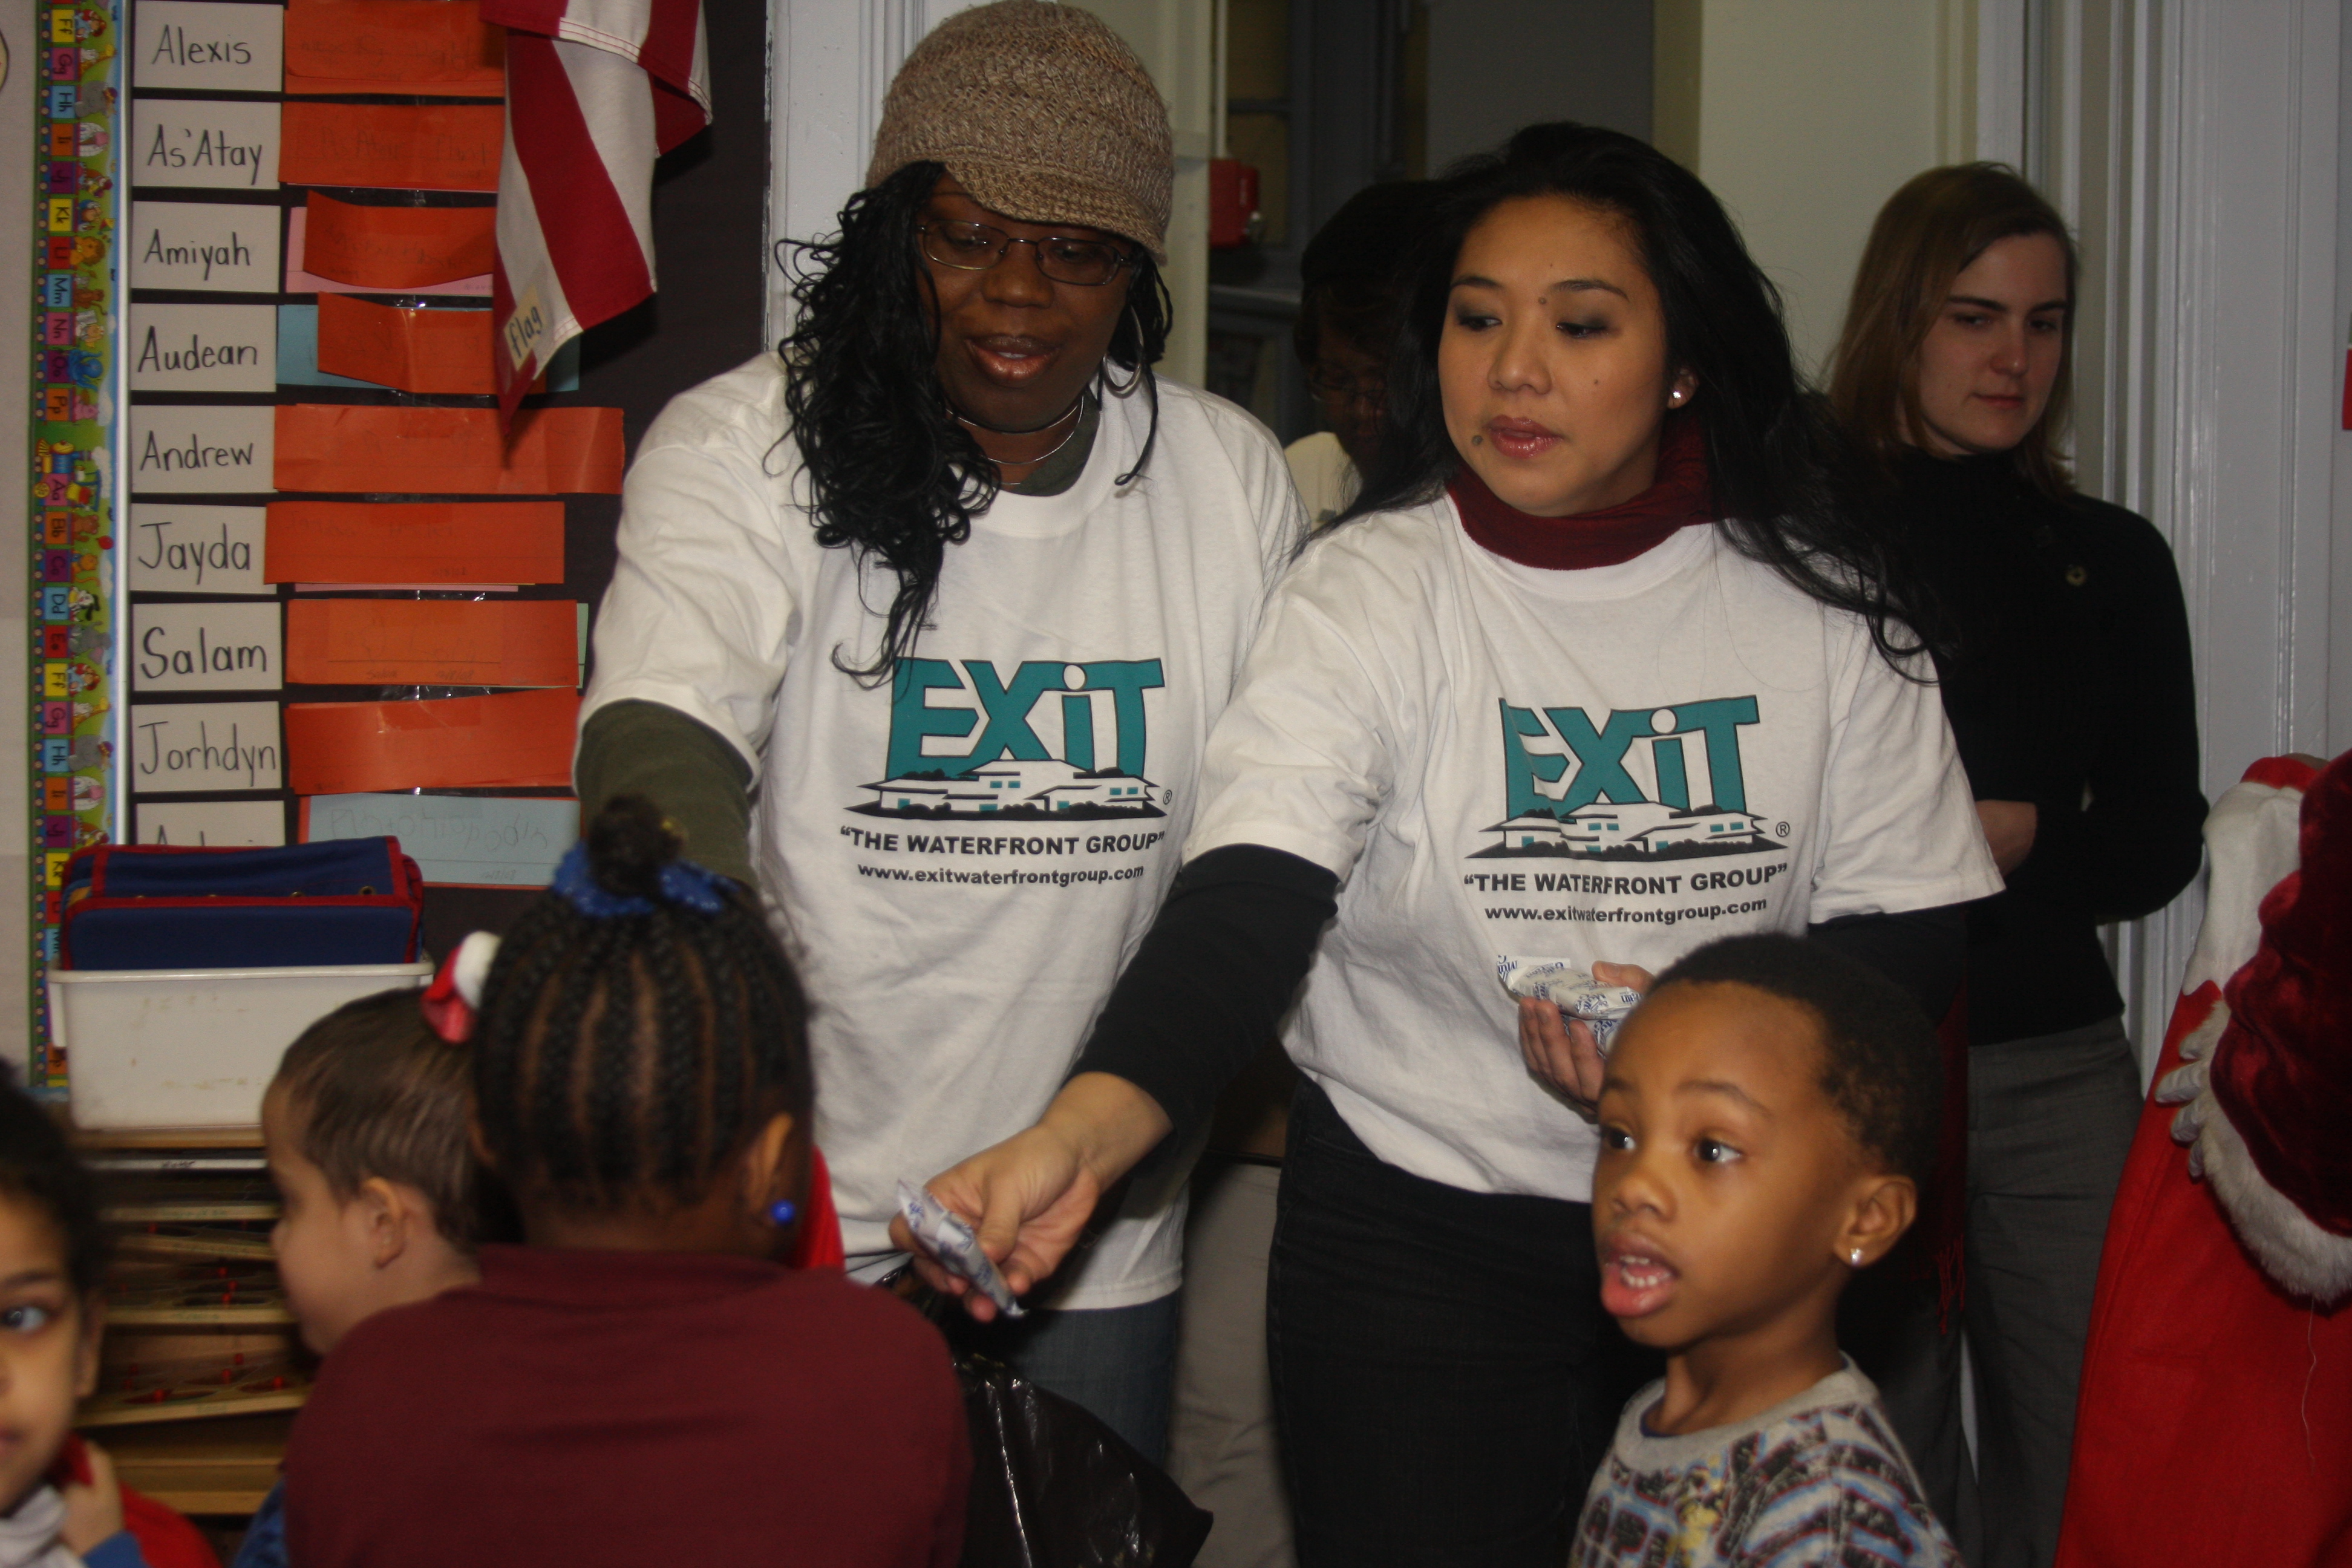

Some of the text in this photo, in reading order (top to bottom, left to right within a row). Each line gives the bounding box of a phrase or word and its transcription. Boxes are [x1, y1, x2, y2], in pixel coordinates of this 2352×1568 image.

[58, 19, 73, 35] Ff
[151, 24, 252, 65] Alexis
[53, 54, 73, 74] Gg
[58, 93, 73, 112] Hh
[56, 207, 70, 224] Kk
[143, 228, 250, 281] Amiyah
[54, 277, 68, 304] Mm
[53, 319, 67, 339] Nn
[137, 325, 257, 373] Audean
[48, 396, 67, 414] Pp
[140, 430, 253, 471] Andrew
[52, 480, 67, 500] Aa
[51, 518, 65, 537] Bb
[138, 521, 250, 585] Jayda
[52, 593, 65, 614] Dd
[140, 626, 267, 679] Salam
[51, 672, 66, 688] Ff
[46, 708, 65, 728] Gg
[51, 746, 65, 765] Hh
[139, 720, 276, 786] Jorhdyn
[907, 834, 1079, 855] WATERFRONT
[857, 863, 1144, 887] www.exitwaterfrontgroup.com
[1534, 873, 1682, 895] WATERFRONT
[1485, 898, 1767, 925] www.exitwaterfrontgroup.com
